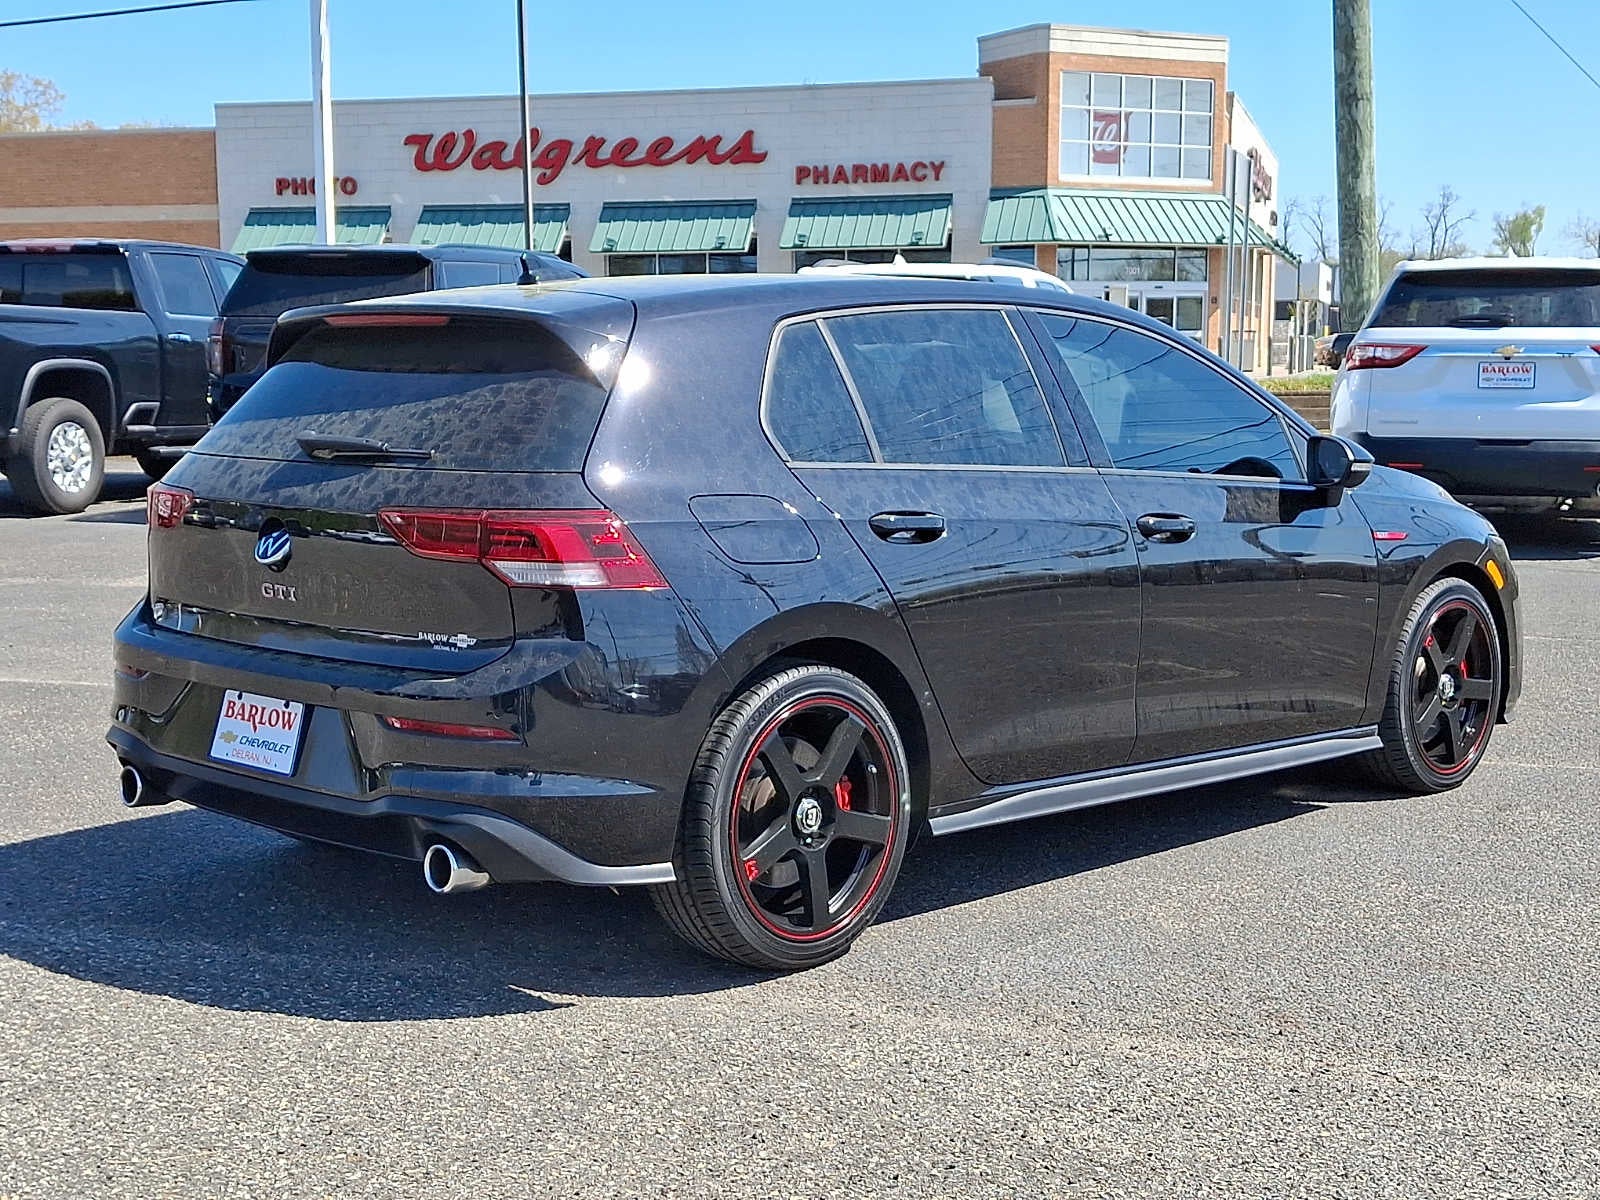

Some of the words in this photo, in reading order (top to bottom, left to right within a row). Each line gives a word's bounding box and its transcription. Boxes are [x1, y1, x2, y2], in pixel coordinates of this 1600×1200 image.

[404, 128, 768, 185] Walgreens
[795, 160, 945, 185] PHARMACY
[275, 176, 358, 196] PHO
[1482, 366, 1532, 376] BARLOW
[262, 582, 297, 601] GTI
[418, 631, 449, 645] BARLOW
[224, 700, 297, 734] BARLOW
[239, 735, 291, 754] CHEVROLET
